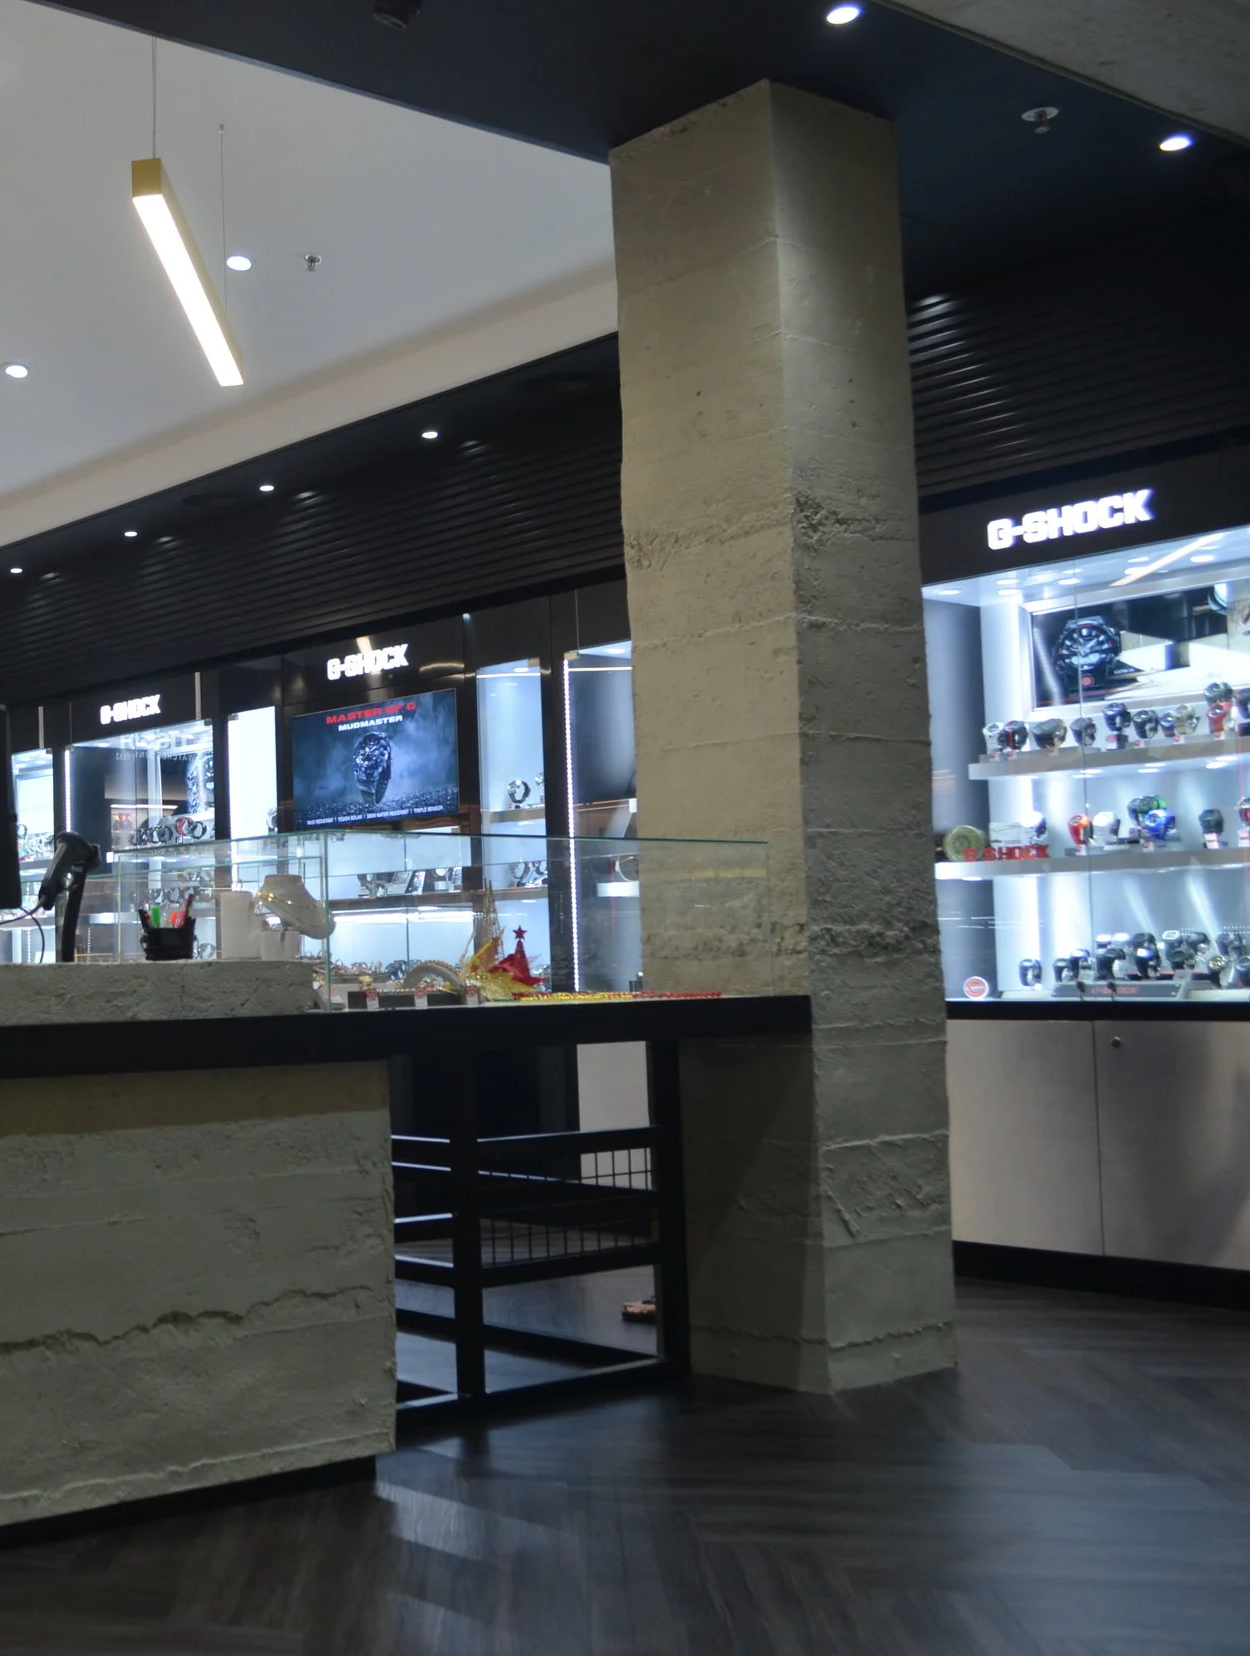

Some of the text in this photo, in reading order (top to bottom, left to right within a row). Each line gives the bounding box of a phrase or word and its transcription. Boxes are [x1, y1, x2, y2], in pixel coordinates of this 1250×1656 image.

[987, 489, 1152, 550] G-SHOCK
[327, 643, 409, 680] G-SHOCK
[326, 707, 382, 725] MASTER
[338, 715, 403, 731] MUDMASTER
